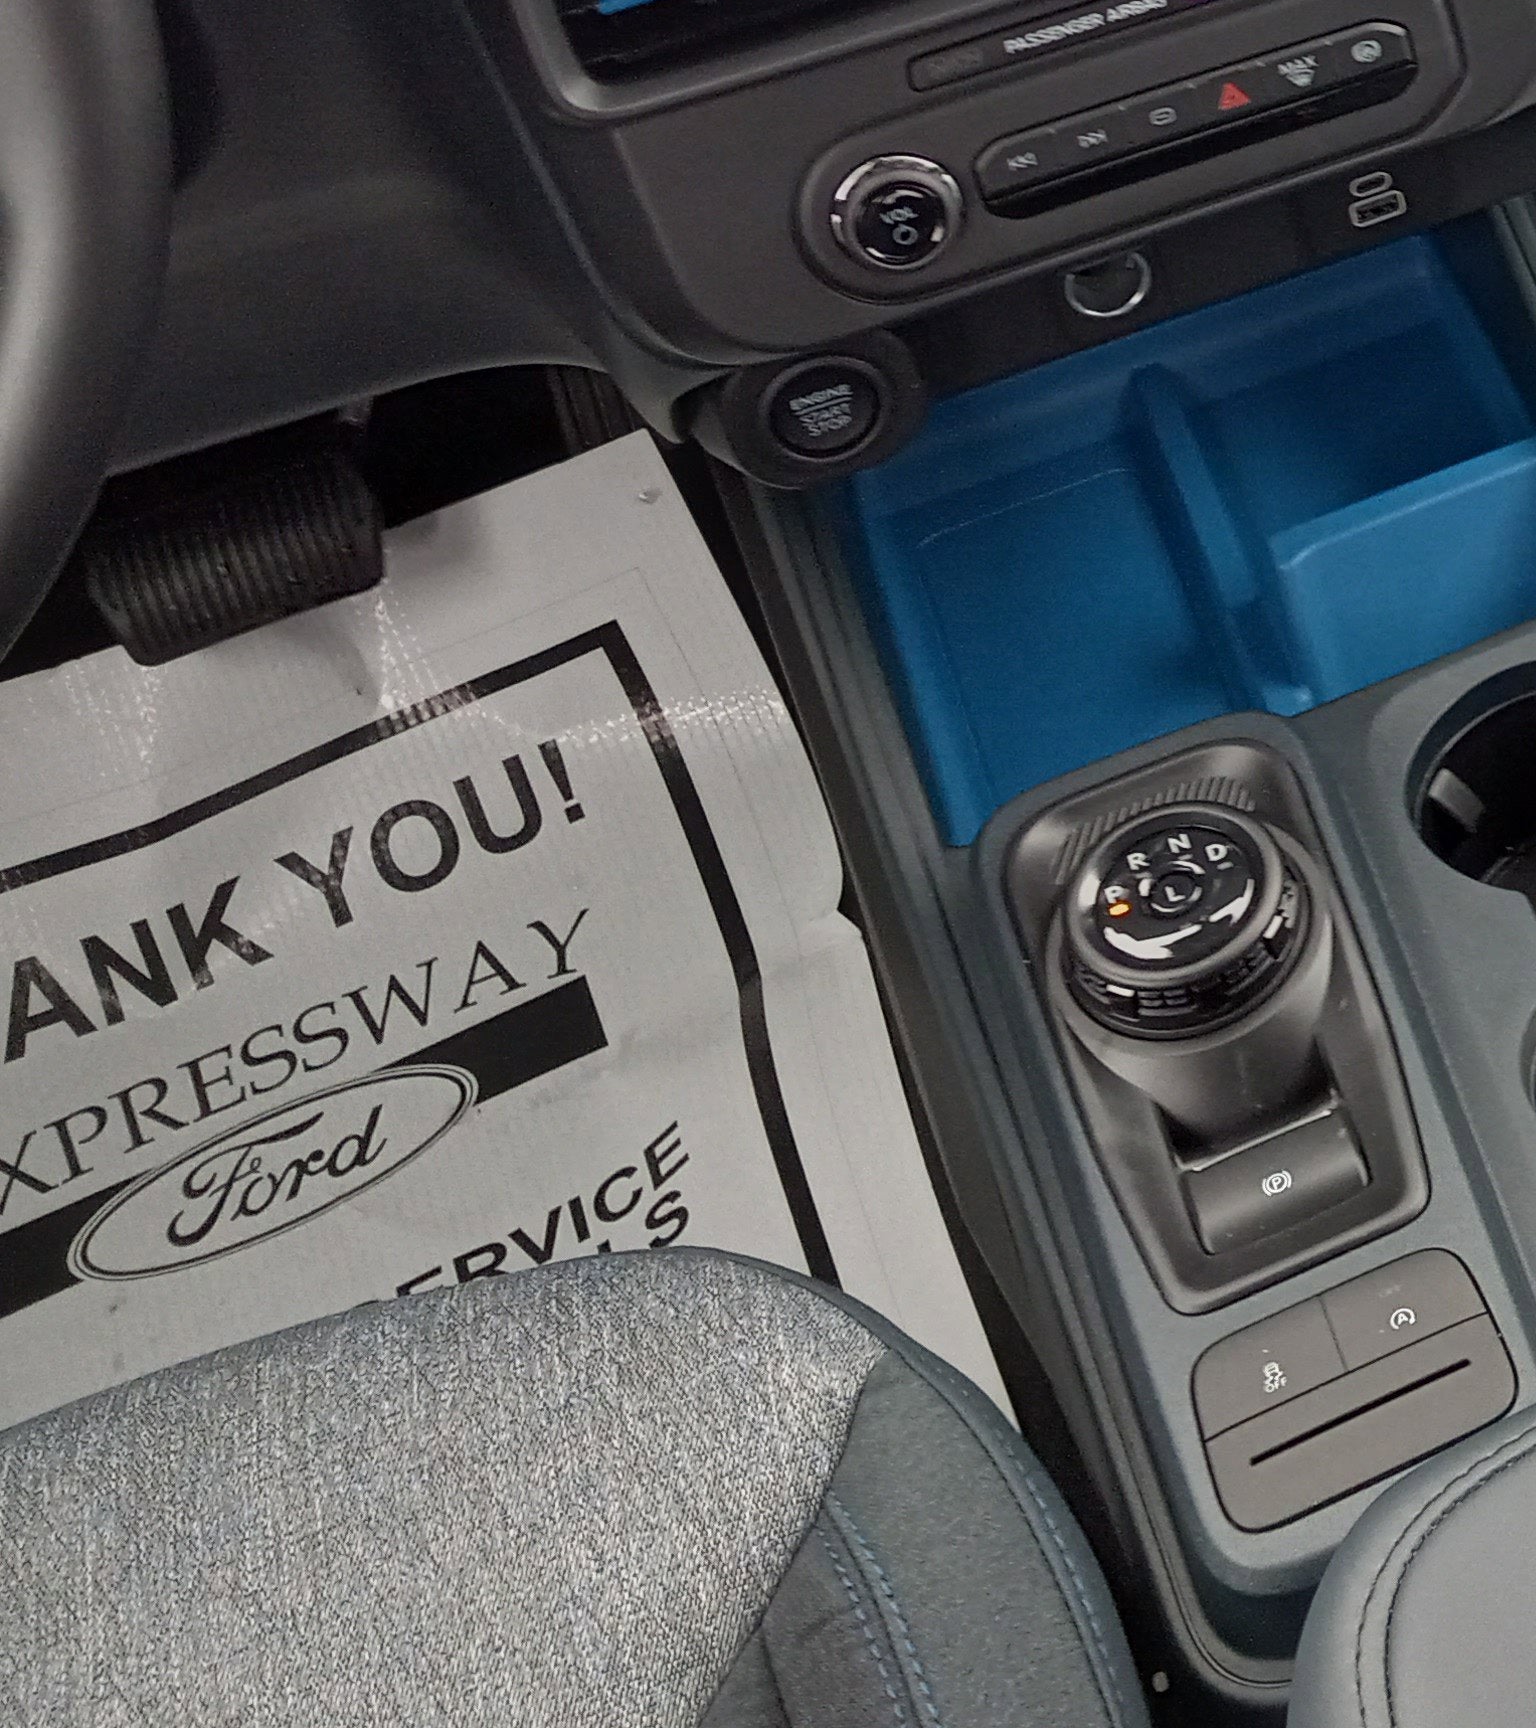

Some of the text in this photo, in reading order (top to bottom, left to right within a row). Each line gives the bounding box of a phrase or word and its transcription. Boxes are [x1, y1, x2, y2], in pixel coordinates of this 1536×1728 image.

[3, 739, 587, 1064] ANK YOU!
[1104, 833, 1228, 904] P R N D
[1164, 885, 1185, 902] L
[0, 908, 591, 1217] XPRESSWAY
[166, 1104, 388, 1250] Ford
[396, 1120, 691, 1297] RVICE
